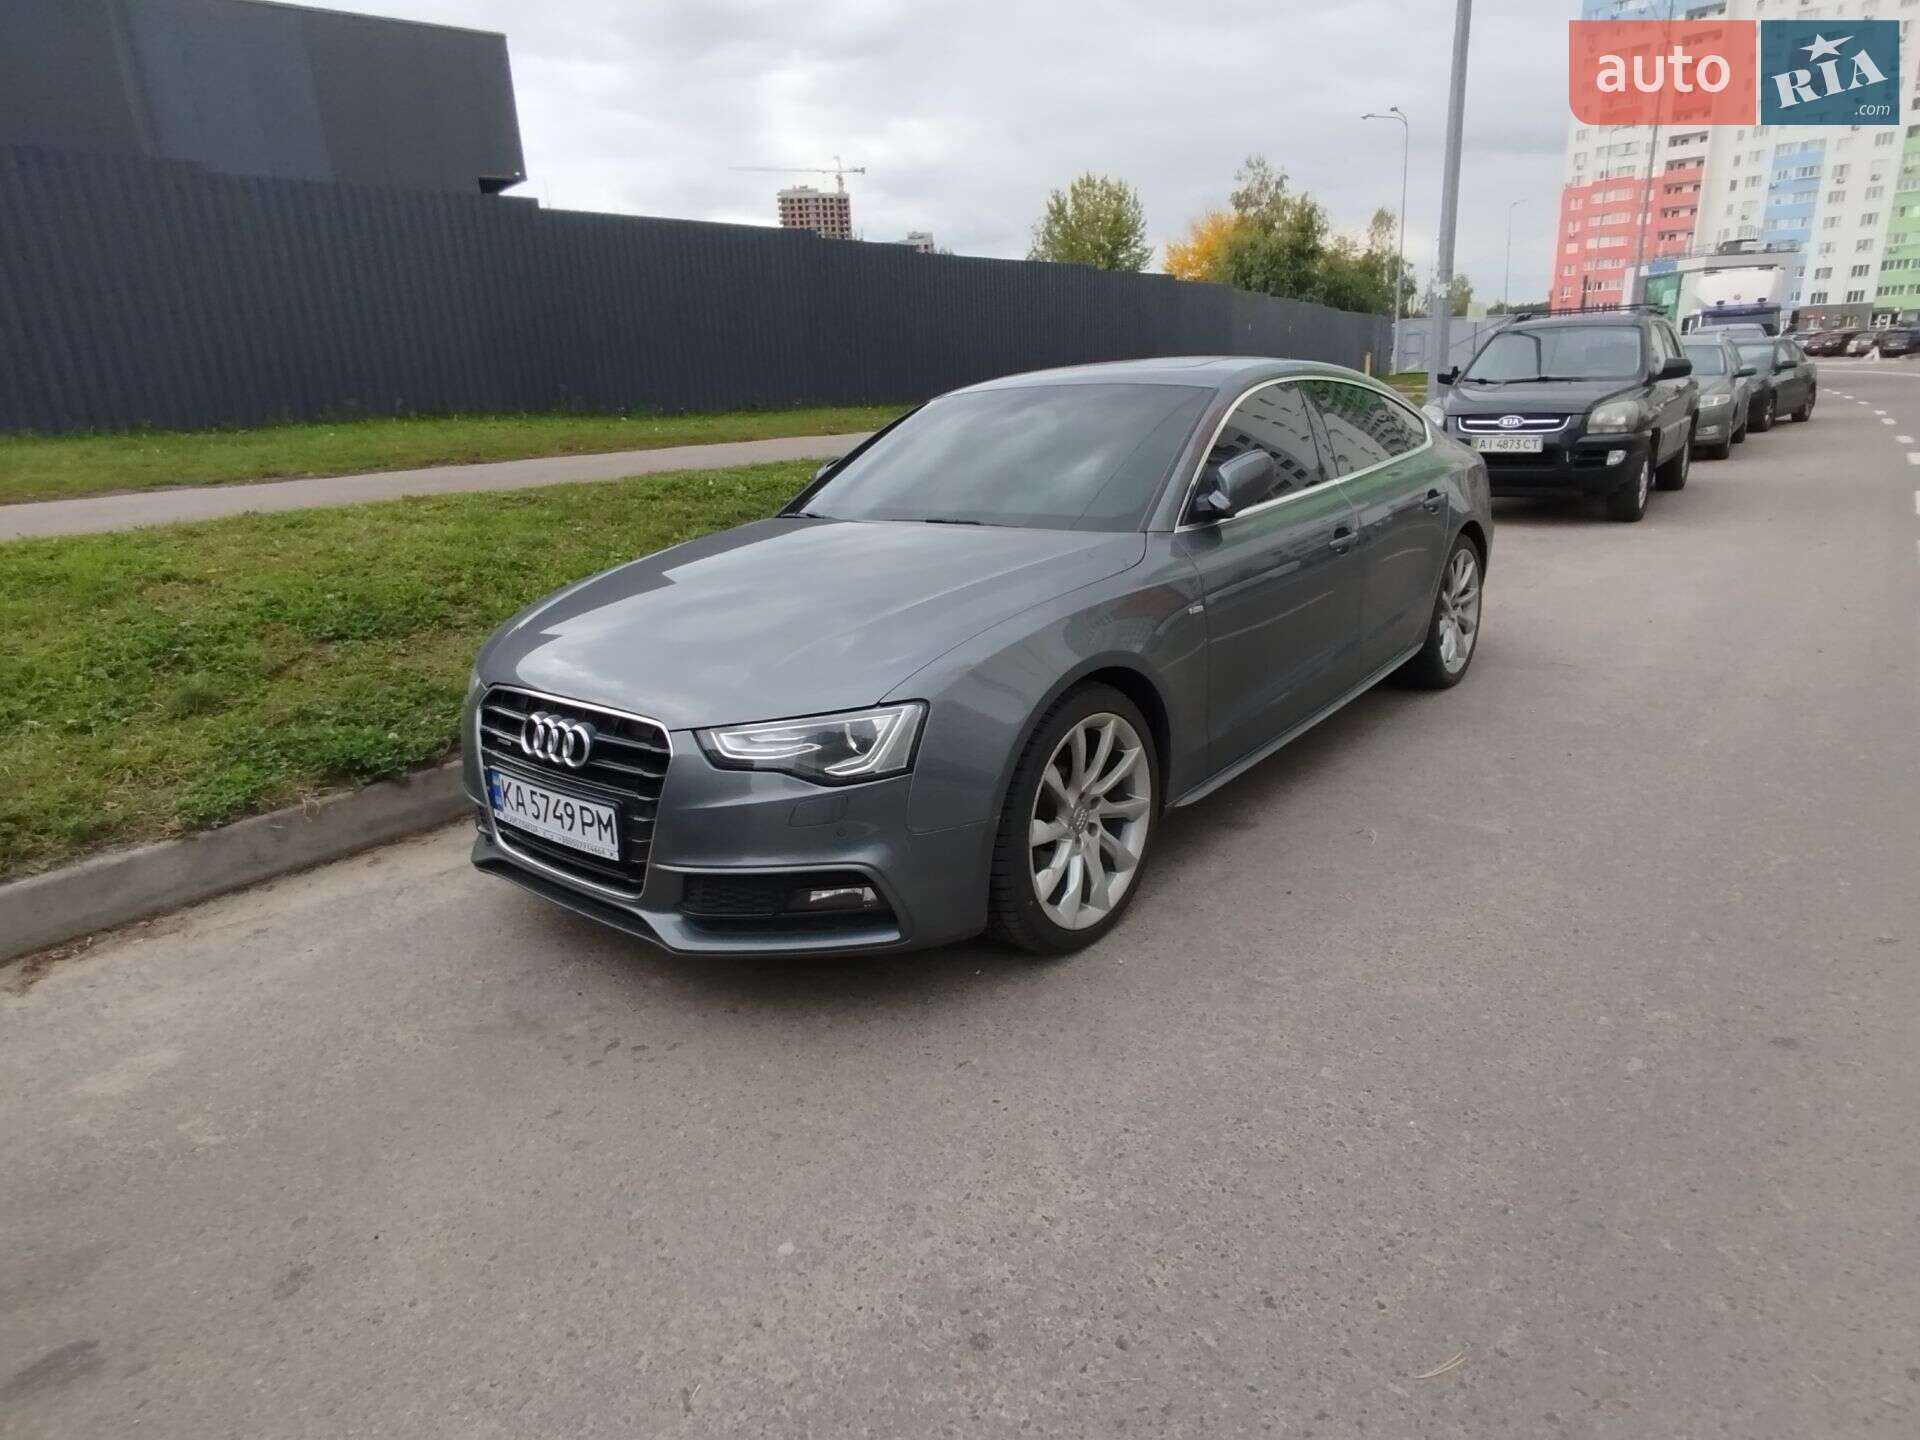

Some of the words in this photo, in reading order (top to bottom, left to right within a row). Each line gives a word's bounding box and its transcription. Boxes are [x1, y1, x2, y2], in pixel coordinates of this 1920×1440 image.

[501, 777, 527, 816] KA
[529, 788, 575, 832] 5749
[579, 805, 616, 845] PM
